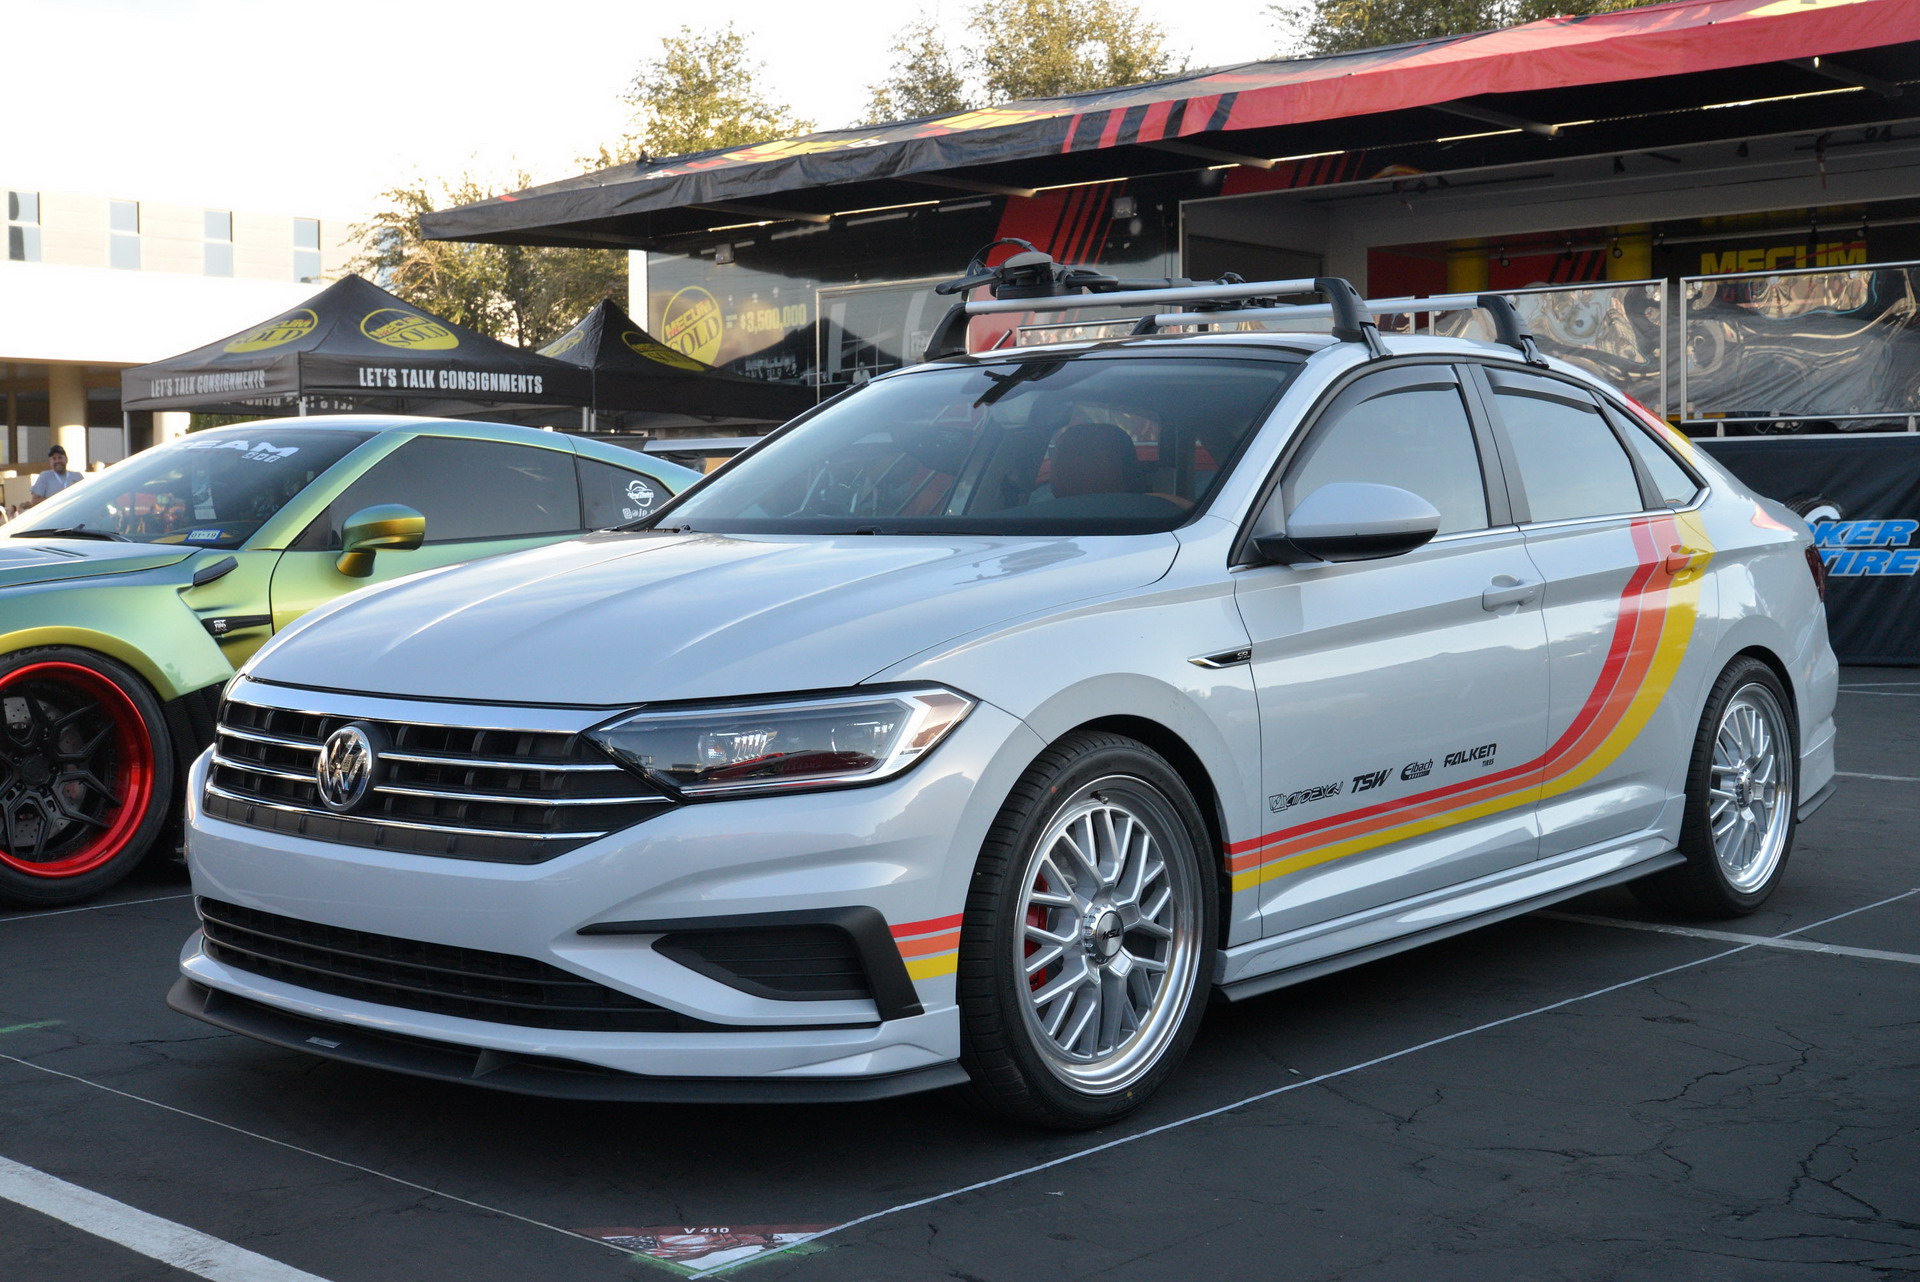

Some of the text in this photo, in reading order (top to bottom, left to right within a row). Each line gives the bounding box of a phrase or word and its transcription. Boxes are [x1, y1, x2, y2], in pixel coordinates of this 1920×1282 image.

[664, 298, 713, 339] MECUM
[386, 325, 449, 346] SOLD
[151, 370, 266, 398] LET'S TALK CONSIGNMENTS
[359, 367, 543, 394] LET'S TALK CONSIGNMENTS
[1807, 519, 1920, 548] KER
[1443, 743, 1497, 768] FALKEN
[1351, 768, 1394, 794] TSW
[1401, 758, 1434, 781] Eibach
